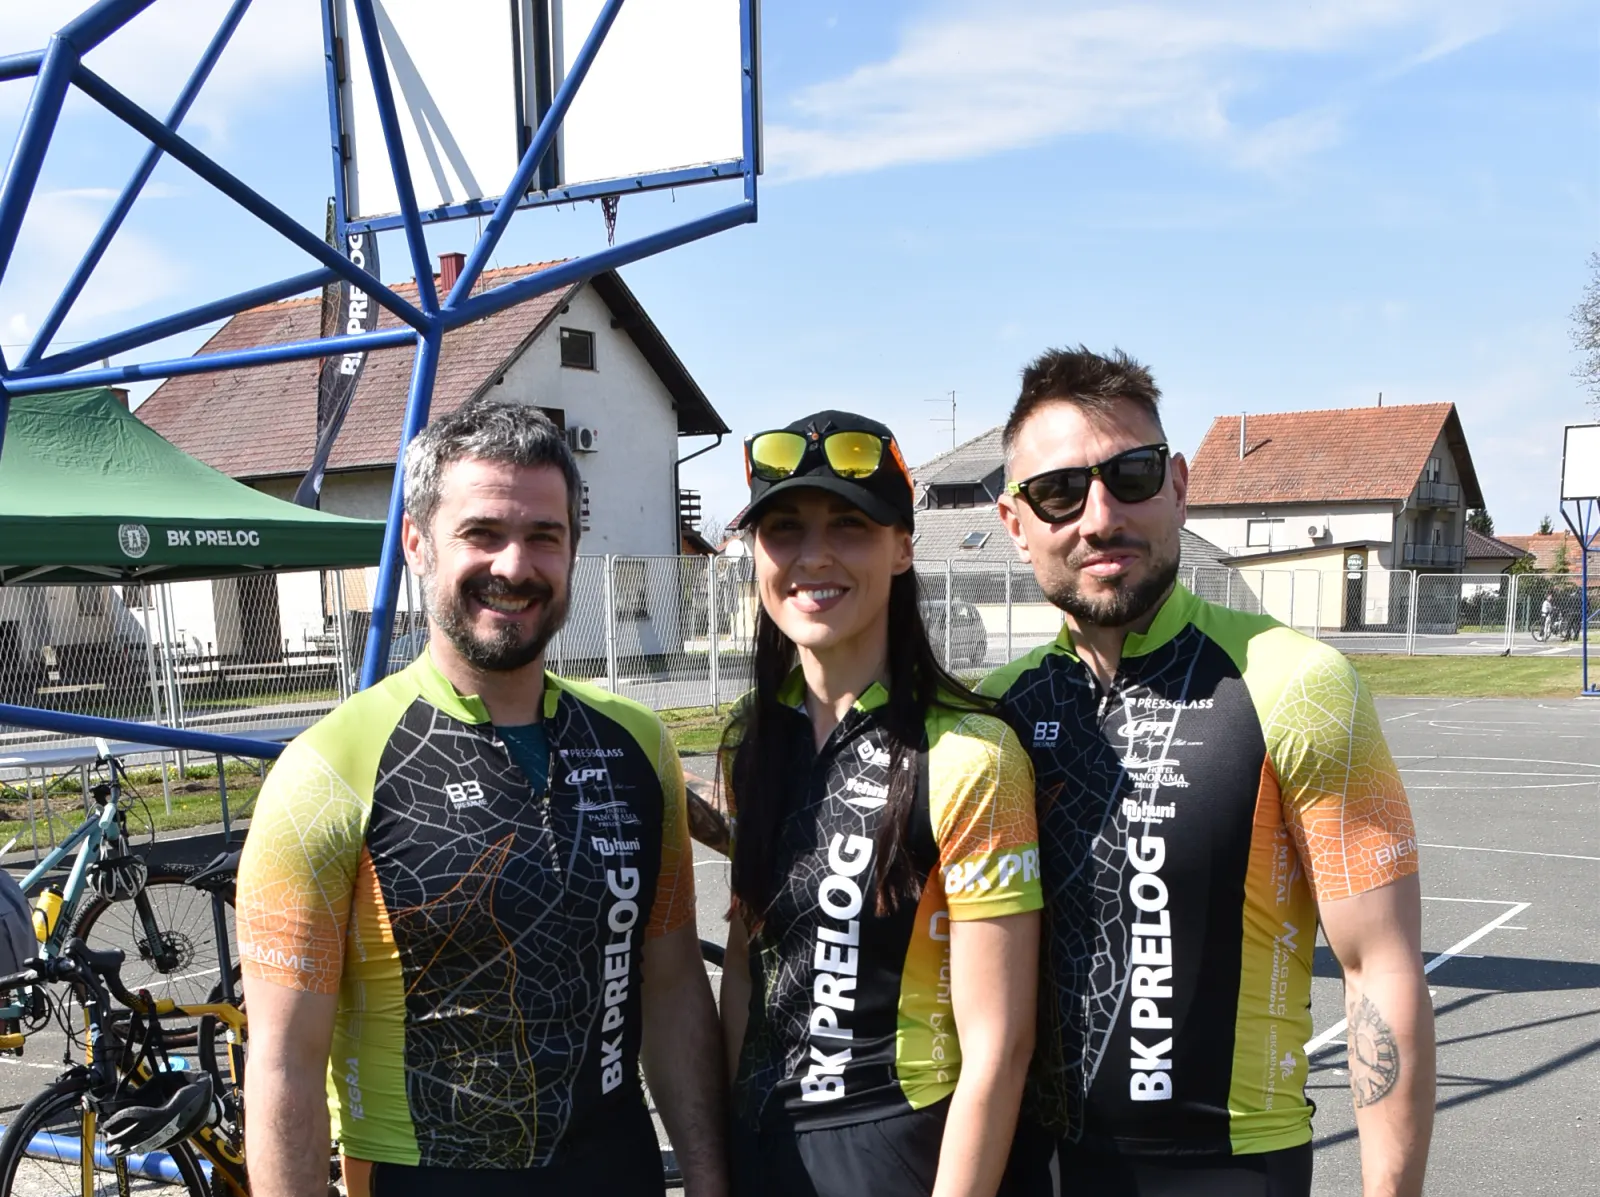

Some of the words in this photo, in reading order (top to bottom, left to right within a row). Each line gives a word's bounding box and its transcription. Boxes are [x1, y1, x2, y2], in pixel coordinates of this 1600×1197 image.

[167, 530, 191, 546] BK
[195, 530, 260, 546] PRELOG
[1137, 699, 1214, 709] PRESSGLASS
[1033, 721, 1060, 740] B3
[570, 748, 624, 757] PRESSGLASS
[567, 768, 607, 784] LPT
[1128, 773, 1185, 782] PANORAMA
[446, 780, 484, 803] B3
[1141, 800, 1177, 819] huni
[944, 859, 991, 895] BK
[1276, 845, 1289, 907] METAL
[809, 832, 874, 1040] PRELOG
[1128, 836, 1173, 1030] PRELOG
[602, 867, 640, 1033] PRELOG
[601, 1030, 623, 1095] BK
[802, 1040, 854, 1102] BK
[1130, 1034, 1173, 1101] BK
